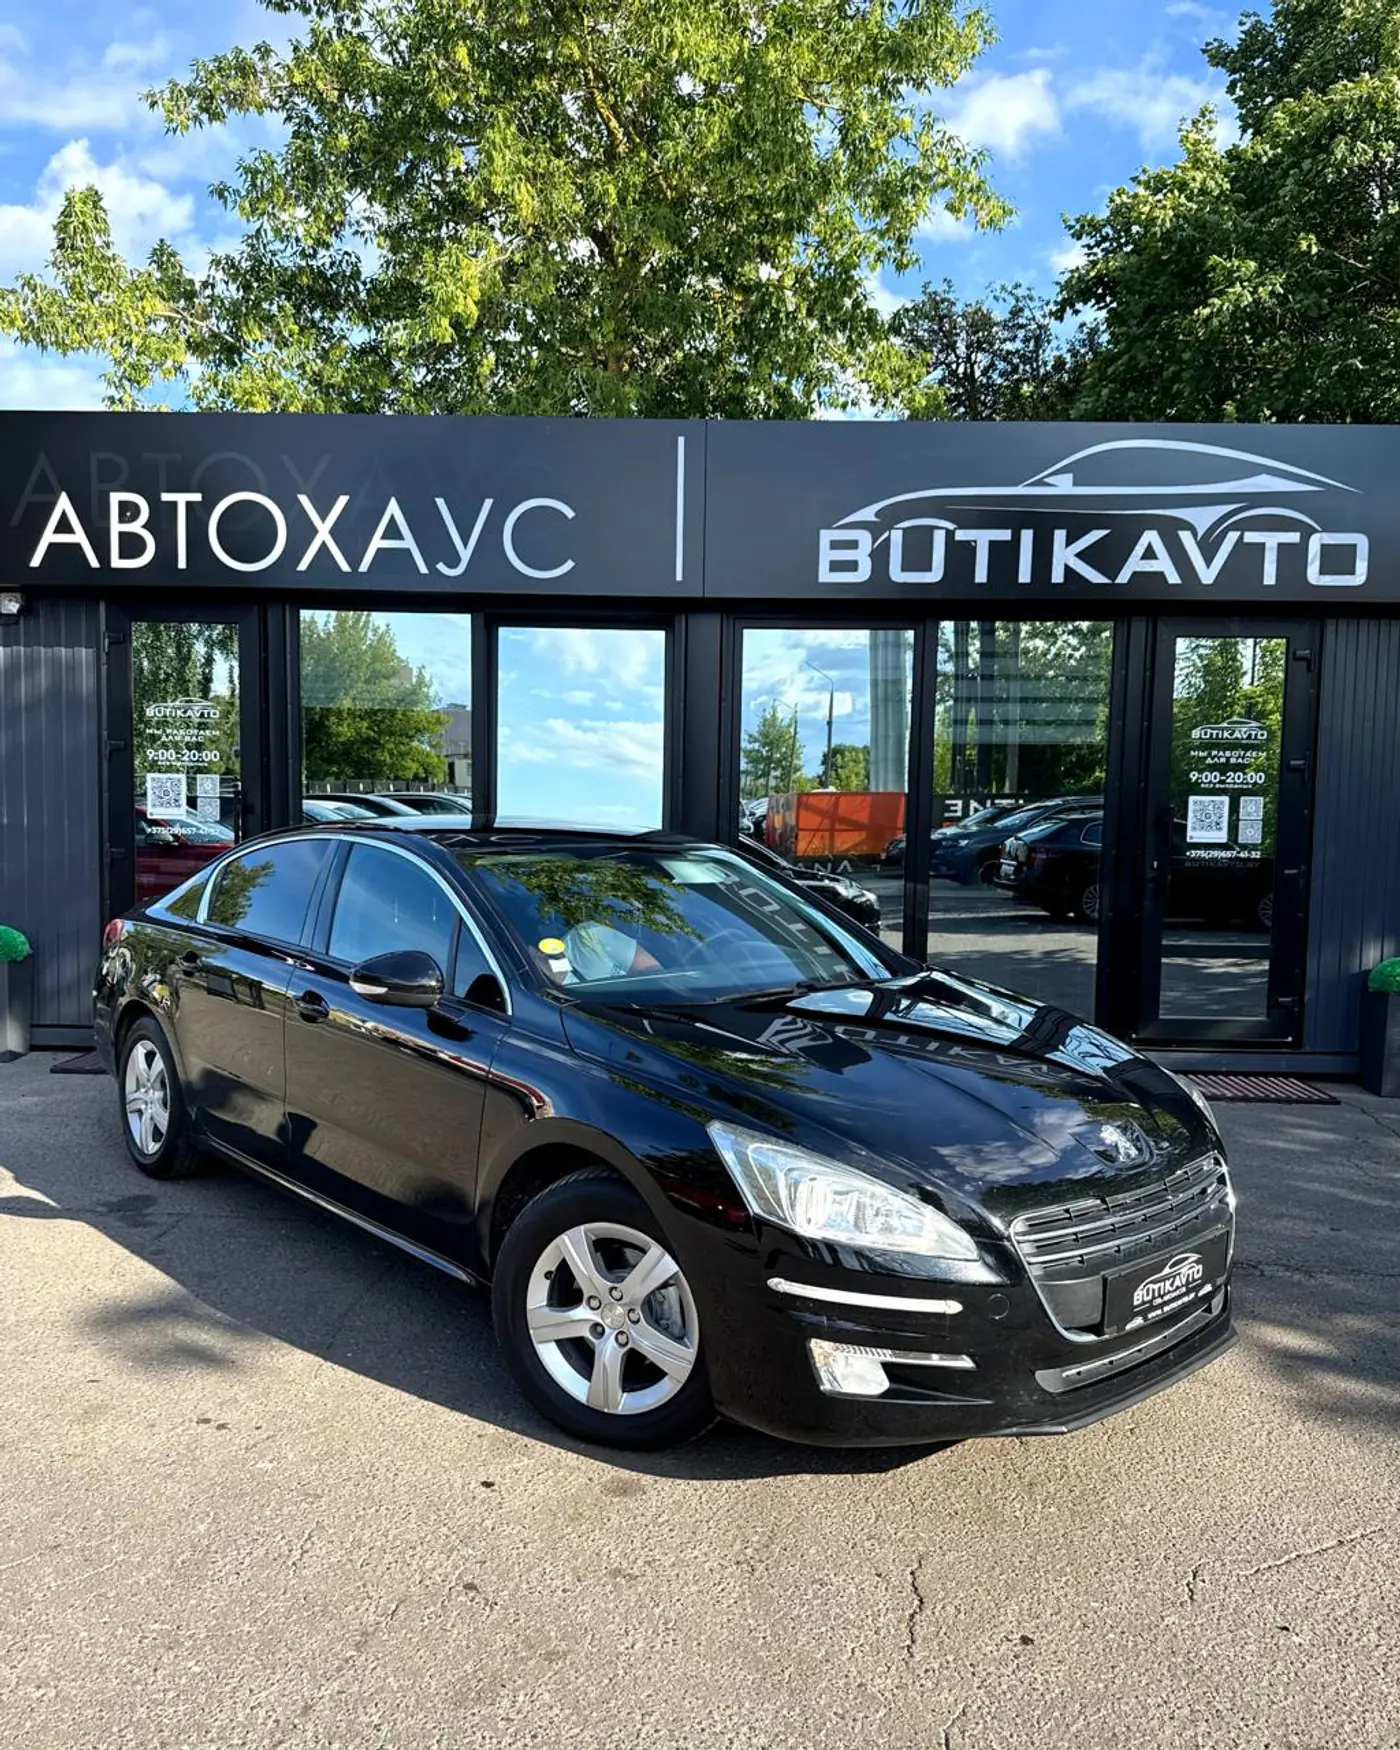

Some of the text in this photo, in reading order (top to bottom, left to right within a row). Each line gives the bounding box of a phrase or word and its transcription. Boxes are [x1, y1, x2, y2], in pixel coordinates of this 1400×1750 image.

[28, 490, 577, 580] АВТОХАУС
[817, 527, 1370, 587] BUTIKAVTO
[146, 707, 220, 718] BUTIKAVTO
[1191, 729, 1268, 740] BUTIKAVTO
[146, 749, 220, 761] 9:00-20:00
[1190, 750, 1267, 758] МЫ РАБОТАЕМ
[1204, 757, 1227, 765] ДЛЯ
[1189, 771, 1266, 784] 9:00-20:00
[1133, 1264, 1203, 1306] BUTIKAVTO
